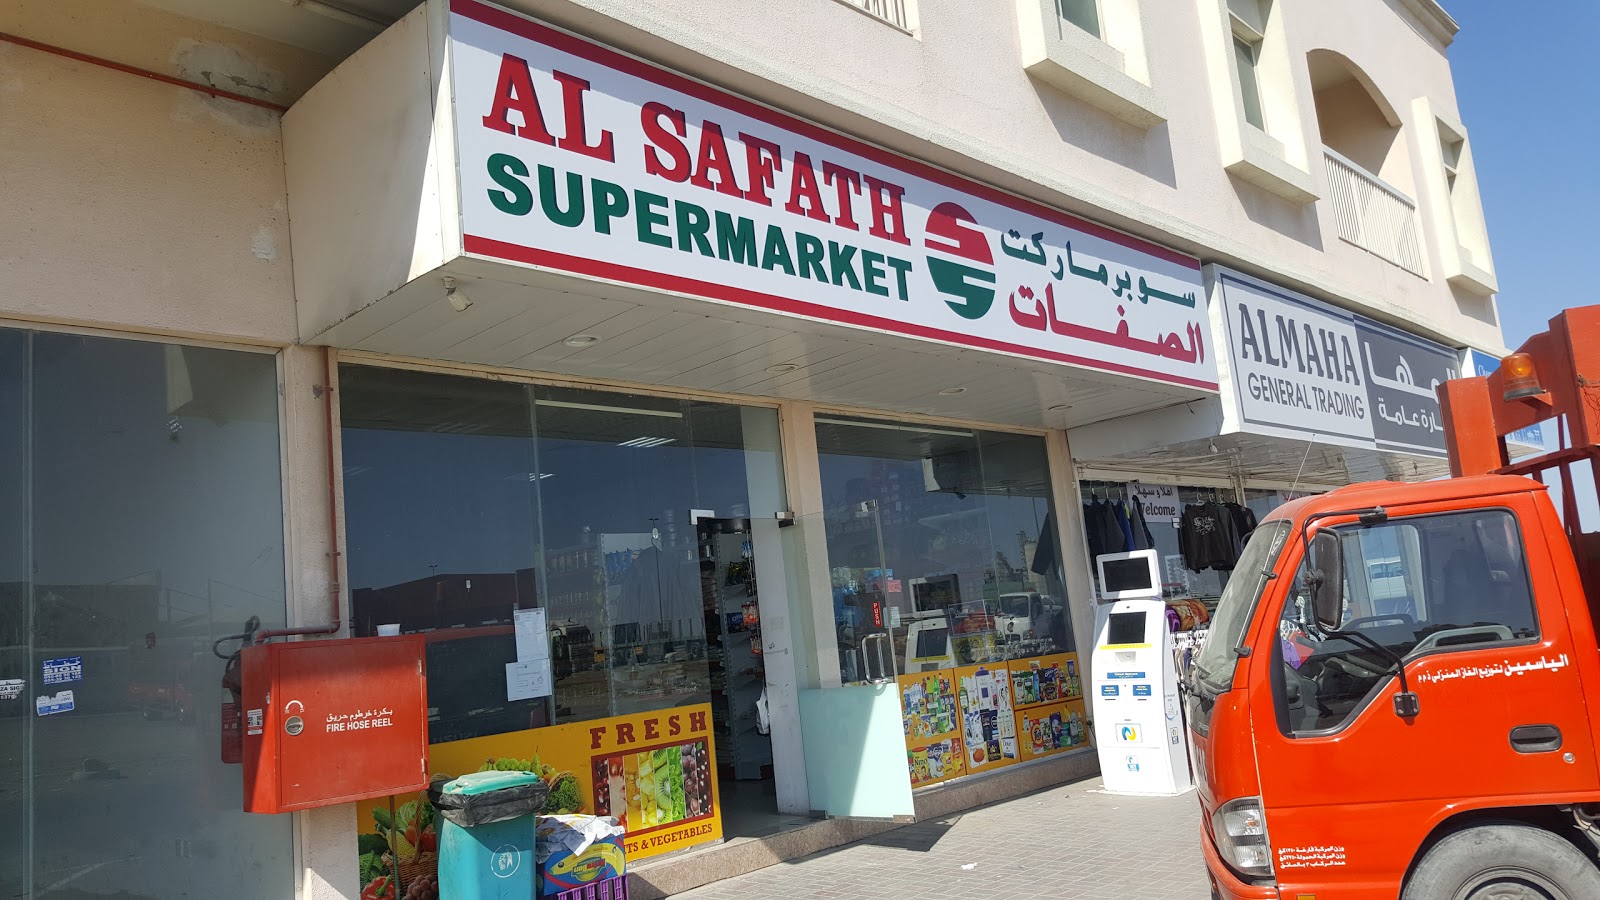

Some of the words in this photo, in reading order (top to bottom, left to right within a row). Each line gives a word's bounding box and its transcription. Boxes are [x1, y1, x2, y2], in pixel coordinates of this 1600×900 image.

[482, 52, 615, 163] AL
[640, 101, 911, 246] SAFATH
[487, 152, 913, 301] SUPERMARKET
[1008, 281, 1205, 365] الصفات
[1239, 302, 1360, 386] ALMAHA
[1364, 341, 1456, 404] مها
[1248, 372, 1312, 409] GENERAL
[1311, 386, 1364, 420] TRADING
[1378, 397, 1420, 426] عامة
[43, 665, 82, 674] SIGN
[1503, 653, 1569, 677] الياسمين
[326, 713, 348, 722] حريق
[326, 722, 345, 732] FIRE
[347, 720, 370, 730] HOSE
[372, 718, 393, 728] REEL
[350, 709, 372, 721] خرطوم
[373, 707, 393, 718] بكرة
[590, 711, 707, 749] FRESH
[641, 840, 649, 850] &
[650, 823, 713, 848] VEGETABLES
